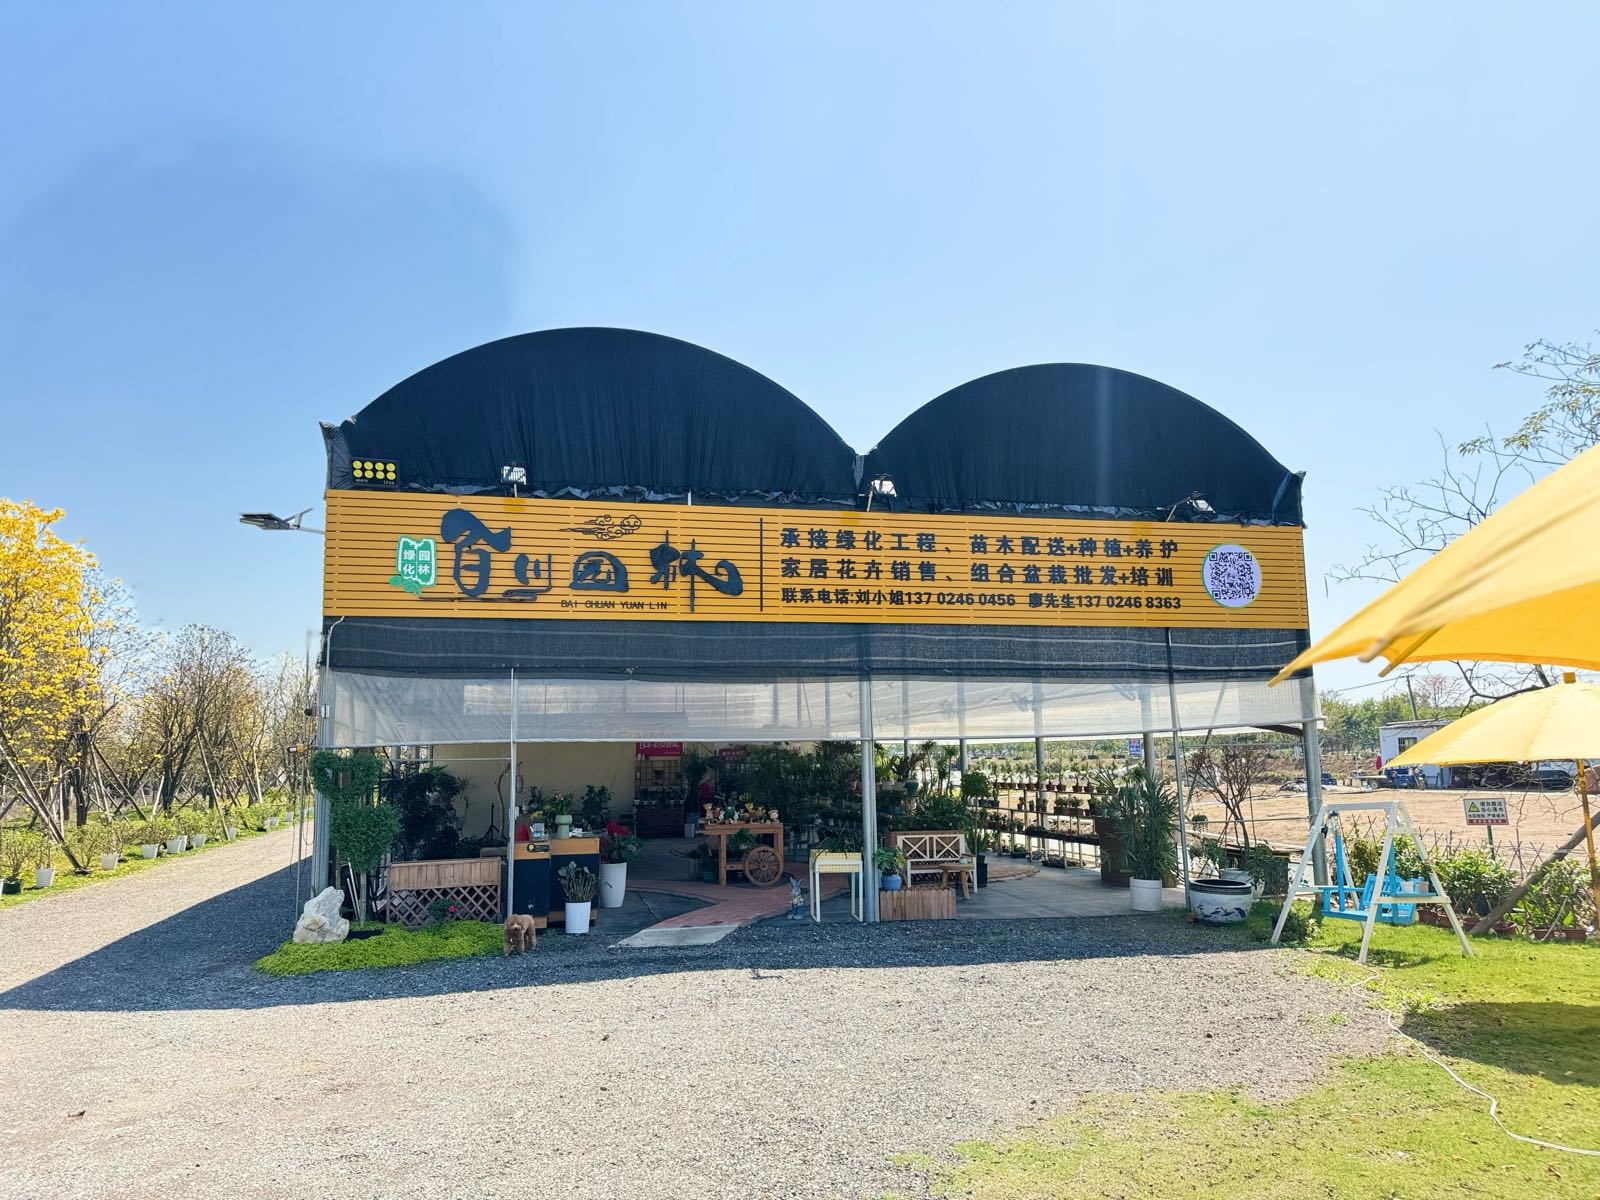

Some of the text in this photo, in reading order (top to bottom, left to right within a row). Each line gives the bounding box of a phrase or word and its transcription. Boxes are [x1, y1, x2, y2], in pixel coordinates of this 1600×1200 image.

[561, 599, 668, 610] BAI CHUAN YUAN LIN
[936, 592, 975, 606] 0246
[978, 593, 1016, 607] 0456
[1106, 595, 1142, 609] 0246
[1145, 596, 1182, 610] 8363
